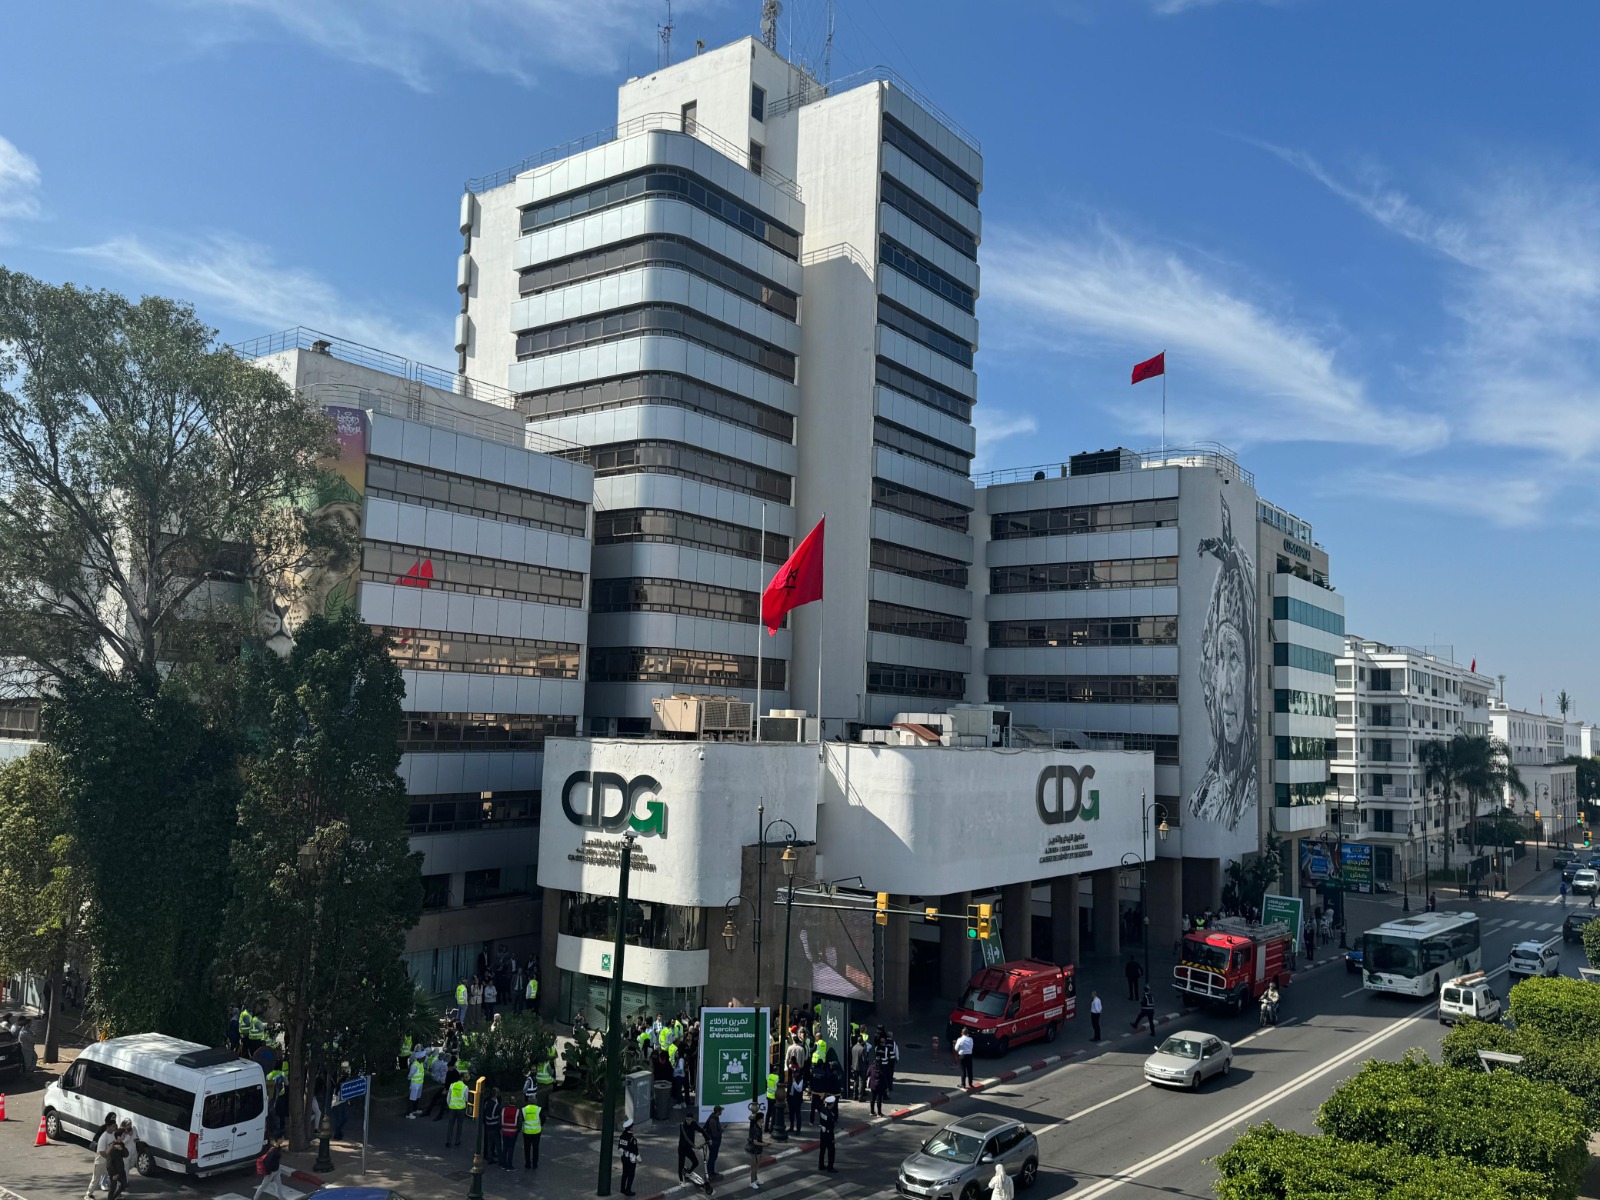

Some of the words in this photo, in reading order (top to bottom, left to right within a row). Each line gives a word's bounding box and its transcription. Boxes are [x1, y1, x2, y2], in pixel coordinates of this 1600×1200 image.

[562, 771, 665, 834] CDG
[1036, 765, 1100, 825] CDG
[728, 1017, 749, 1027] تمرين
